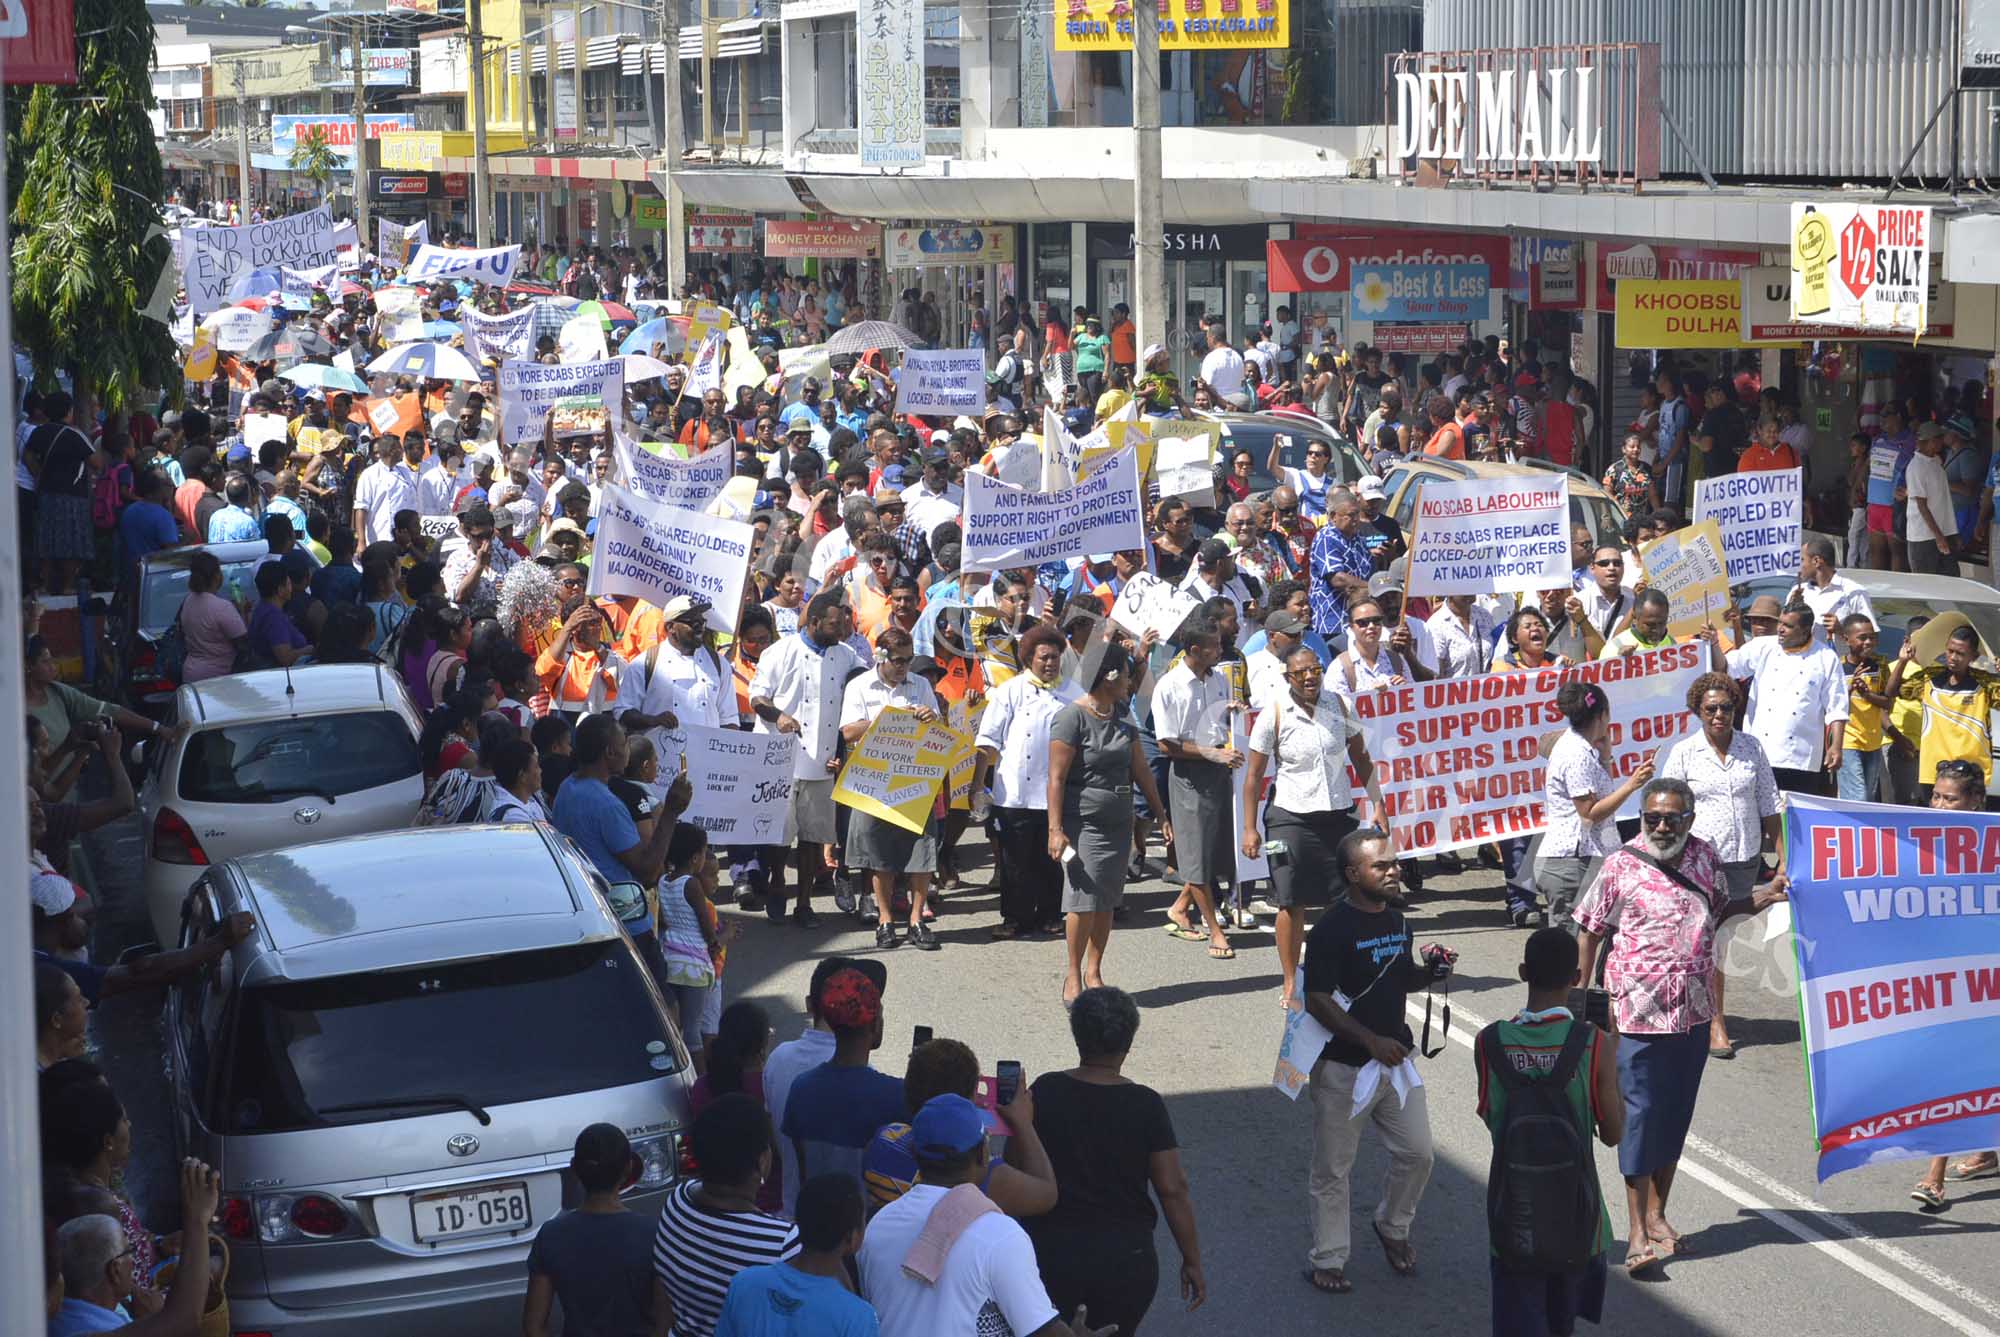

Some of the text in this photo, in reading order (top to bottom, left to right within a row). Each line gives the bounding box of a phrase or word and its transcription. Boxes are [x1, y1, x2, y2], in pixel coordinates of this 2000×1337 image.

[1066, 17, 1275, 34] SENTAI RESTAURANT
[369, 56, 391, 69] THE
[865, 41, 892, 143] SENTAI
[1394, 67, 1602, 161] DEE MALL
[295, 122, 367, 145] BARGAI
[382, 181, 425, 189] SKYGLORY
[197, 210, 331, 253] END CORRUPTION
[768, 234, 880, 245] MONEY EXCHANGE
[1877, 209, 1924, 247] PRICE
[199, 233, 319, 278] END LOCKOUT
[421, 253, 508, 275] FICTU
[1609, 255, 1654, 278] DELUXE
[1669, 259, 1748, 280] DELUX
[1393, 269, 1486, 298] Best & Less
[1544, 280, 1574, 288] DELUXE
[1405, 300, 1469, 315] Your Shop
[1762, 326, 1840, 337] MONEY EXCHANGE
[518, 370, 542, 384] MORE
[544, 367, 573, 382] SCABS
[576, 362, 620, 379] EXPECTED
[949, 359, 981, 371] BROTHERS
[521, 383, 604, 402] TO BE ENGAGED BY
[919, 376, 967, 388] IN AGAINST
[907, 392, 933, 405] LOCKED
[950, 394, 976, 406] WORKERS
[645, 465, 724, 482] SCABS LABOUR
[995, 477, 1108, 508] AND FAMILIES FORM
[1704, 474, 1798, 503] A.T.S GROWTH
[970, 489, 1134, 528] SUPPORT RIGHT TO PROTEST
[1422, 490, 1560, 517] NO SCAB LABOUR!!!
[1706, 499, 1794, 527] CRIPPLED BY
[605, 503, 631, 521] A.T.S
[654, 522, 746, 558] SHAREHOLDERS
[966, 528, 1049, 547] MANAGEMENT
[1058, 509, 1138, 537] GOVERNMENT
[1420, 523, 1561, 546] A.T.S SCABS REPLACE
[641, 536, 697, 565] BLATAINLY
[1023, 537, 1082, 560] INJUSTICE
[1413, 541, 1567, 563] LOCKED-OUT WORKERS
[1651, 535, 1722, 575] WE SIGN ANY
[607, 541, 724, 593] SQUANDERED BY 51%
[607, 561, 663, 588] MAJORITY
[1433, 560, 1545, 581] AT NADI AIRPORT
[1649, 549, 1706, 581] WON'T RETURN
[1663, 560, 1691, 583] WORK
[1680, 595, 1719, 617] SLAVS!
[1355, 644, 1699, 719] ADE UNION CONGRESS
[890, 714, 907, 723] WE
[1396, 700, 1565, 747] SUPPORTS
[1631, 710, 1694, 743] OUT
[872, 735, 946, 752] RETURN ANY
[878, 725, 956, 742] WON'T SIGN
[708, 737, 794, 756] Truth KNOW
[865, 748, 914, 764] TO WORK
[850, 764, 941, 782] WE ARE LETTERS!
[752, 780, 792, 803] Justice
[852, 783, 924, 806] NOT SLAVES!
[1391, 802, 1549, 852] NO RETRE
[1811, 825, 1898, 882] FIJI
[1824, 971, 1957, 1031] DECENT
